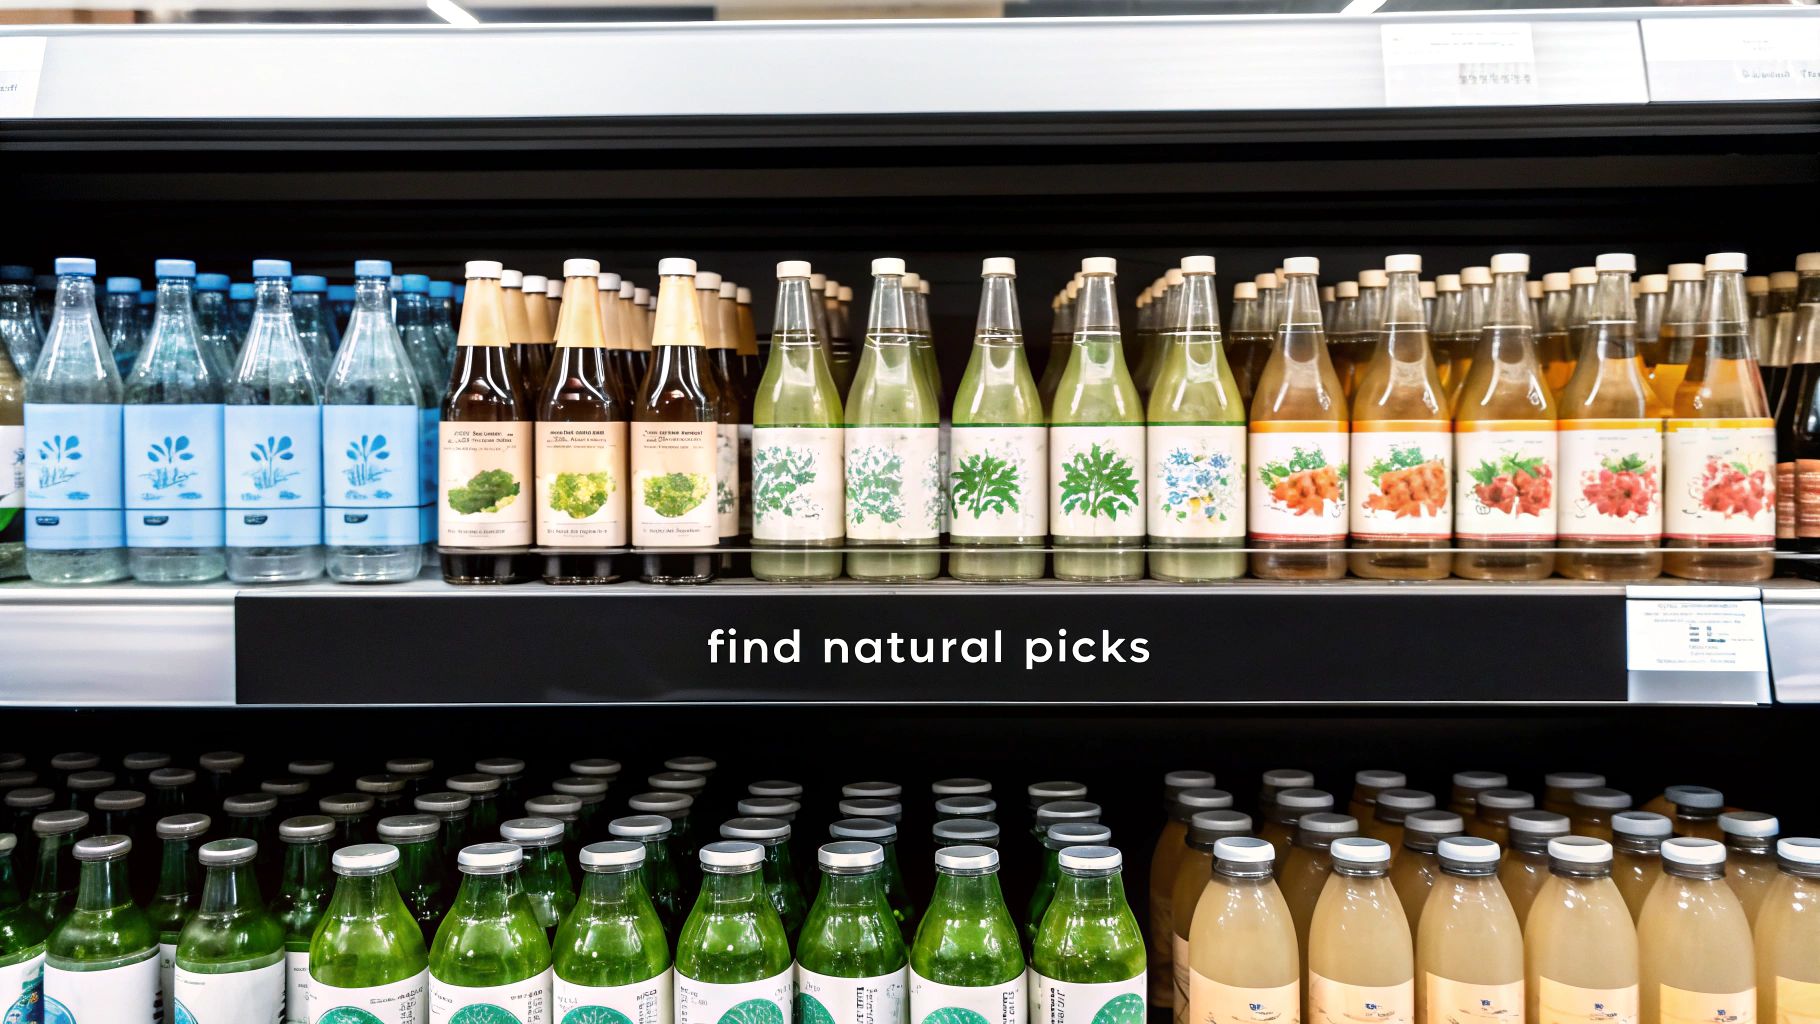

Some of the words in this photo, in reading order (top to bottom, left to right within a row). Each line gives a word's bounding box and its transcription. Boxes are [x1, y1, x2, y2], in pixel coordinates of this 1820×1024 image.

[707, 628, 801, 664] find
[824, 629, 1002, 664] natural
[1025, 628, 1150, 670] picks
